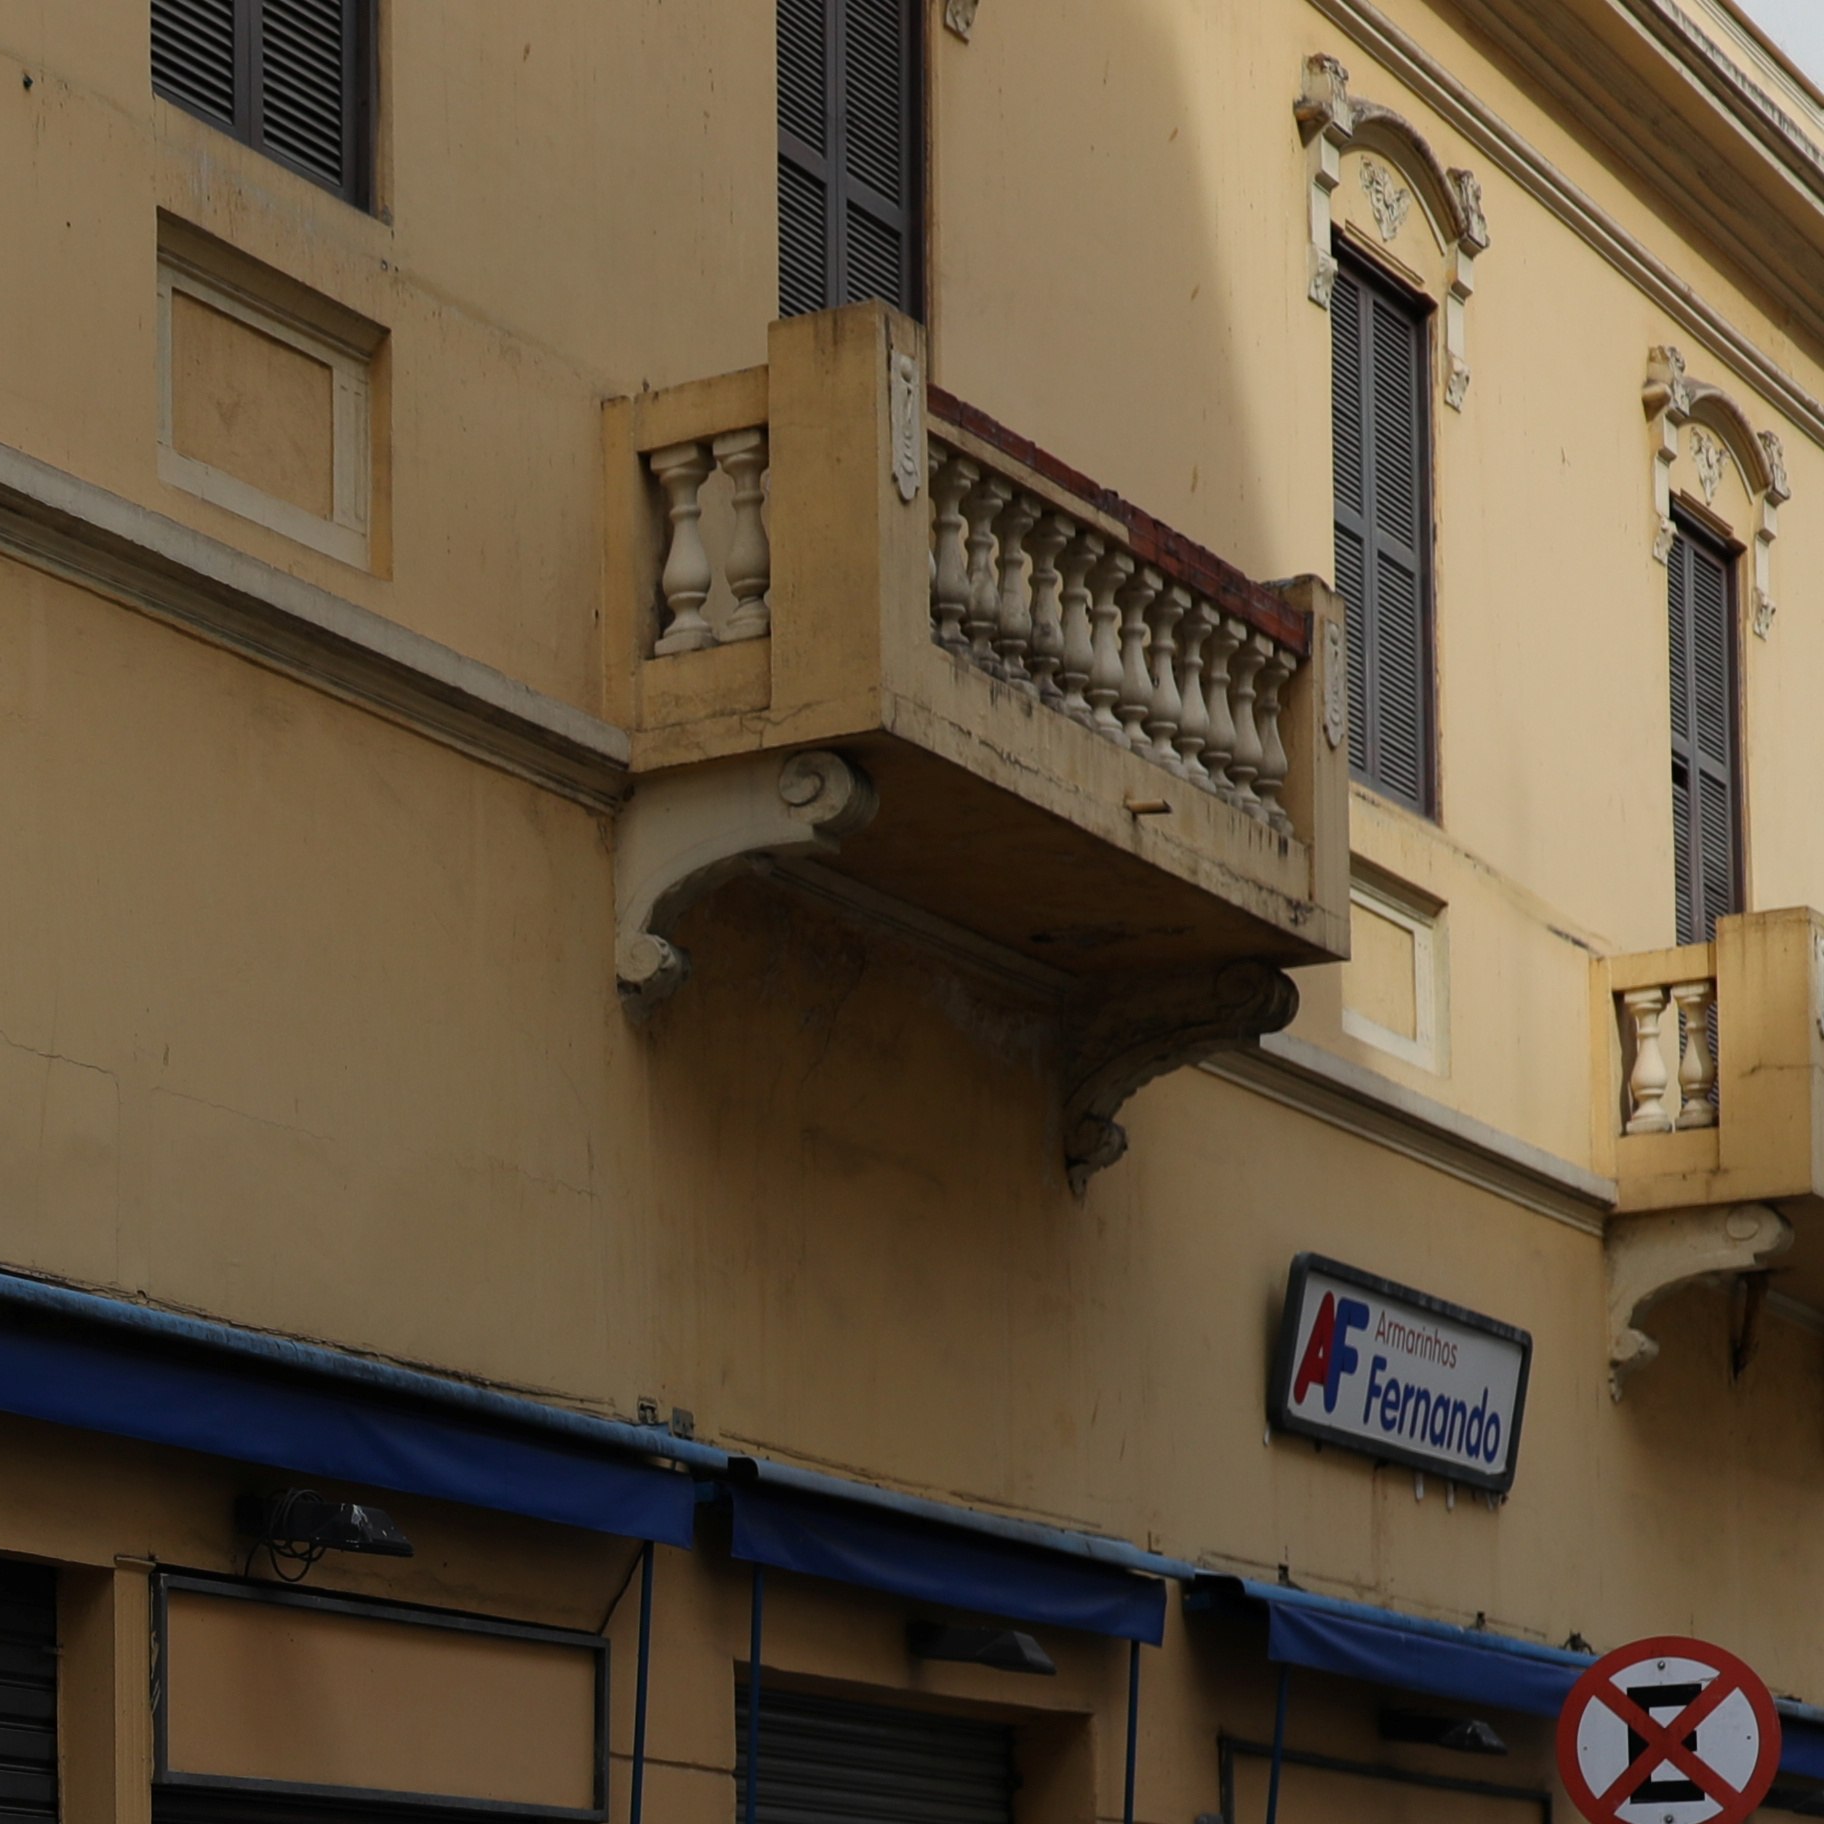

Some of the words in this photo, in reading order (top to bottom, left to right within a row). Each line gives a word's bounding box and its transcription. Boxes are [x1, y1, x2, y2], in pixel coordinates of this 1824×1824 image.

[1293, 1290, 1370, 1414] AF
[1374, 1310, 1459, 1369] Armarinhos
[1362, 1355, 1502, 1464] Fernando
